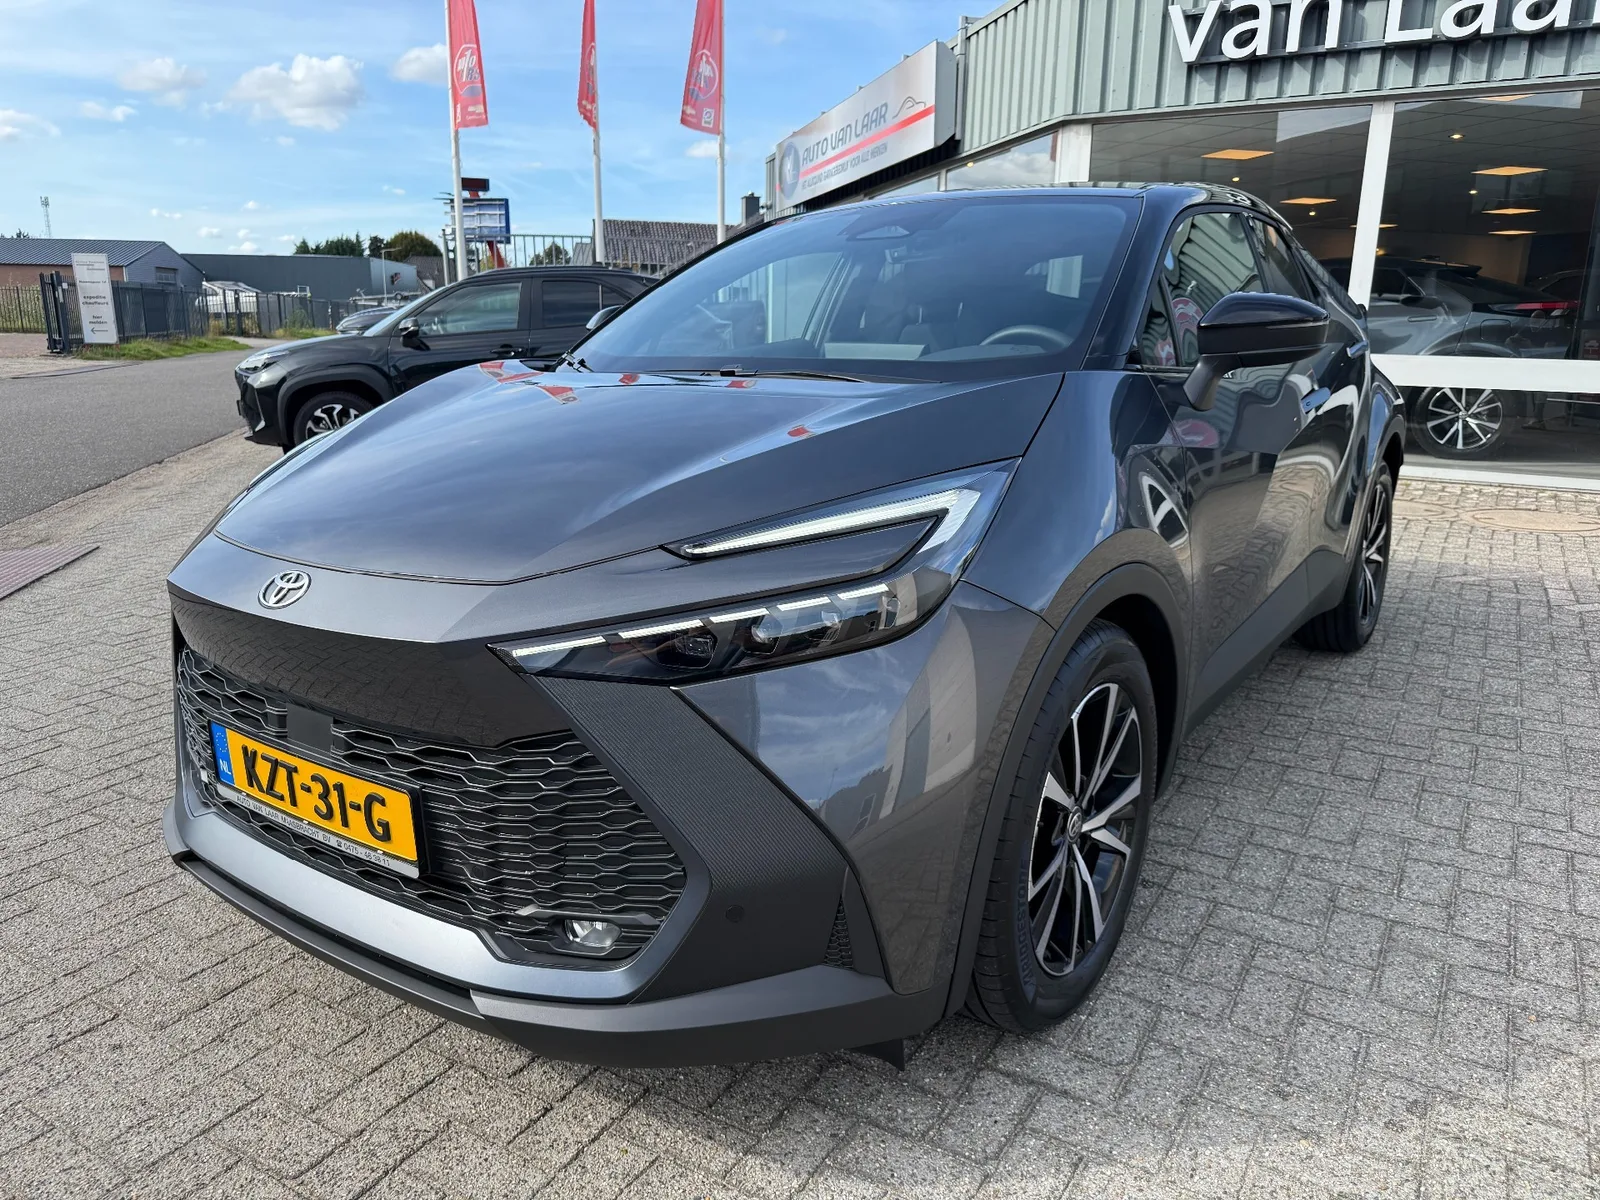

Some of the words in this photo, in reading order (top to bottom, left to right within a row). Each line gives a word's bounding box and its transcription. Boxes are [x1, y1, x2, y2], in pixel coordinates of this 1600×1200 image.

[1168, 0, 1342, 63] van
[1385, 0, 1600, 43] Laa
[802, 137, 829, 166] AUTO
[830, 123, 852, 150] VAN
[855, 102, 888, 138] LAAR
[219, 758, 232, 776] NL
[241, 744, 392, 843] KZT-31-G
[236, 795, 251, 808] AUTO
